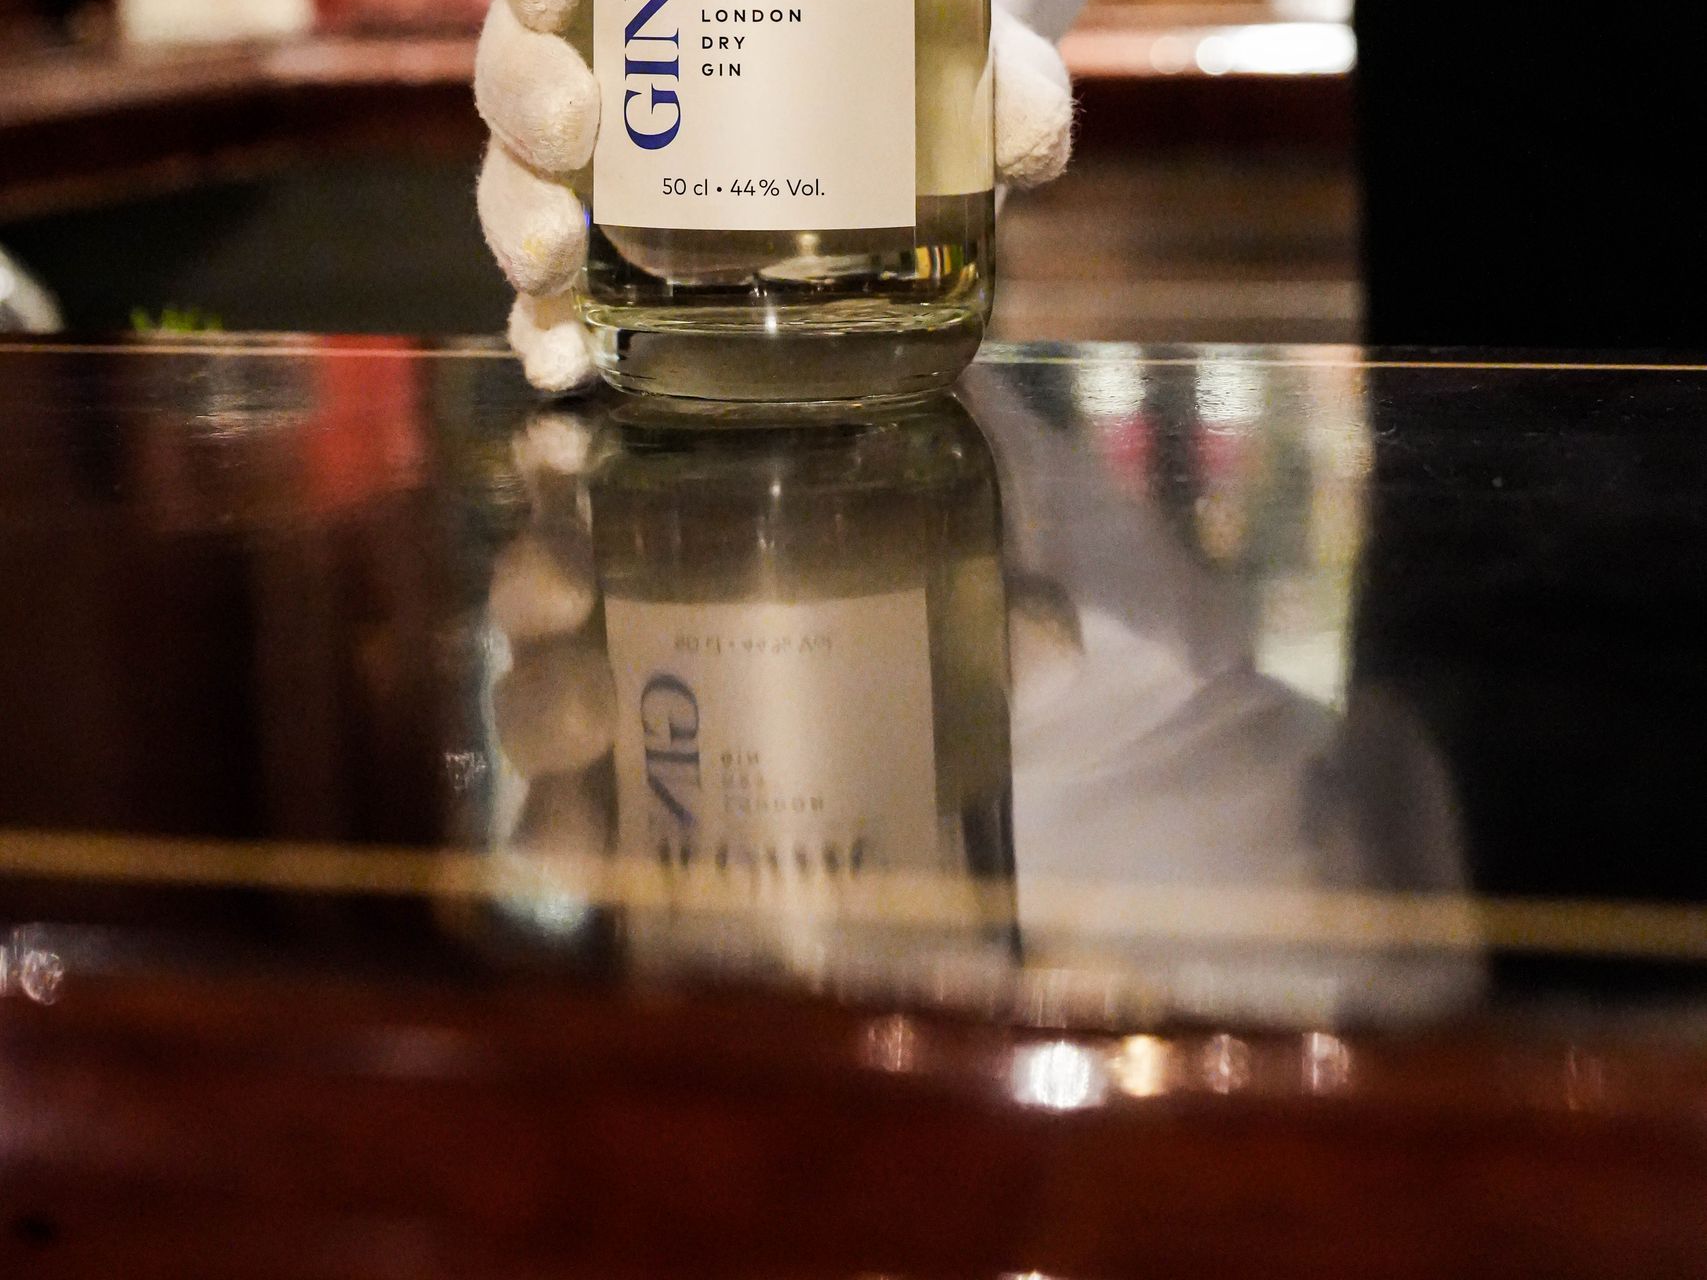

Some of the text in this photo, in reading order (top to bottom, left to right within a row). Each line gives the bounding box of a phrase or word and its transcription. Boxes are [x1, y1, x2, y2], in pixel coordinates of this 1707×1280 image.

[701, 8, 802, 23] LONDON
[701, 35, 746, 50] DRY
[701, 62, 742, 77] GIN
[662, 177, 687, 196] 50
[693, 178, 708, 197] cl
[729, 178, 780, 197] 44%
[785, 177, 826, 197] Vol.
